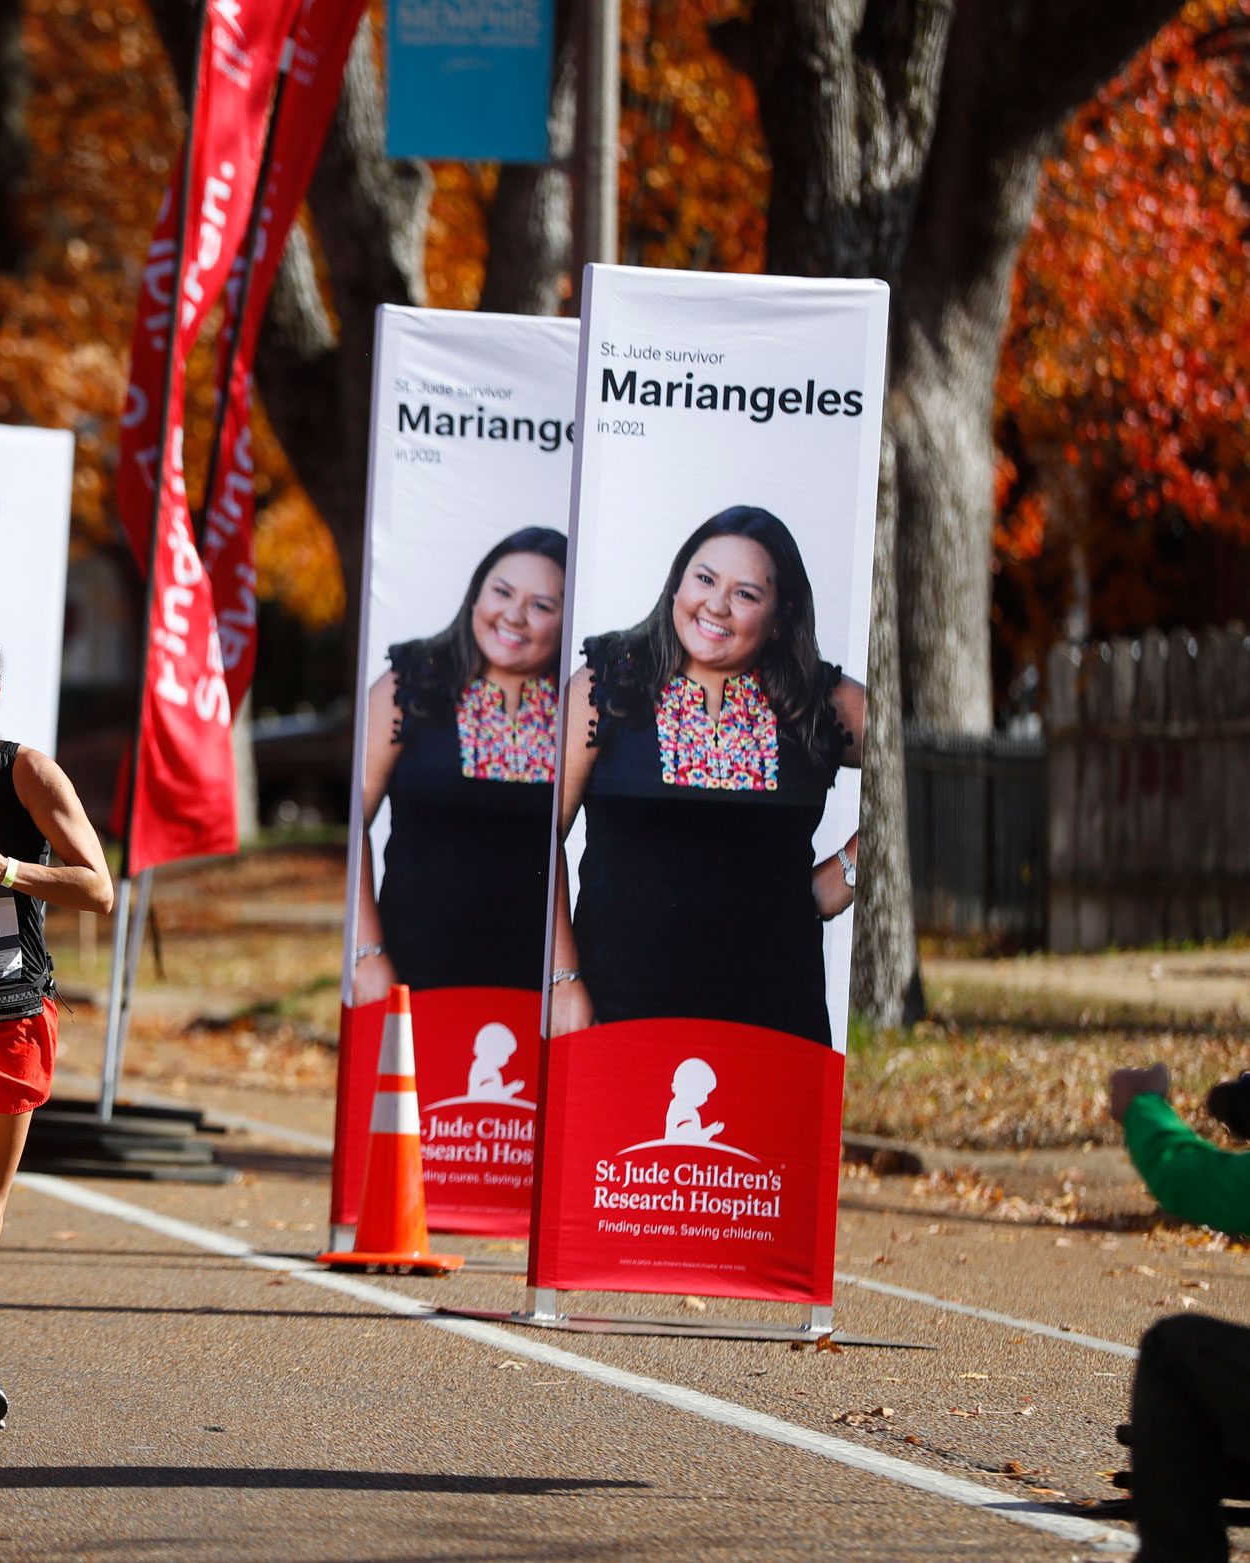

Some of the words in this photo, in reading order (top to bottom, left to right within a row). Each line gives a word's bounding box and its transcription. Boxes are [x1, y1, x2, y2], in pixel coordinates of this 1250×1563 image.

[600, 342, 618, 358] St.
[624, 344, 661, 361] Jude
[665, 347, 725, 365] survivor
[418, 381, 453, 396] Jude
[600, 367, 863, 424] Mariangeles
[398, 402, 576, 452] Mariange
[596, 418, 610, 435] in
[612, 420, 646, 437] 2021
[428, 1116, 474, 1142] Jude
[420, 1140, 488, 1163] esearch
[595, 1160, 620, 1183] St.
[622, 1161, 670, 1188] Jude
[674, 1163, 782, 1192] Children's
[593, 1186, 685, 1212] Research
[688, 1190, 781, 1222] Hospital
[598, 1218, 641, 1236] Finding
[643, 1223, 678, 1237] cures.
[680, 1222, 720, 1240] Saving
[722, 1225, 775, 1242] children.
